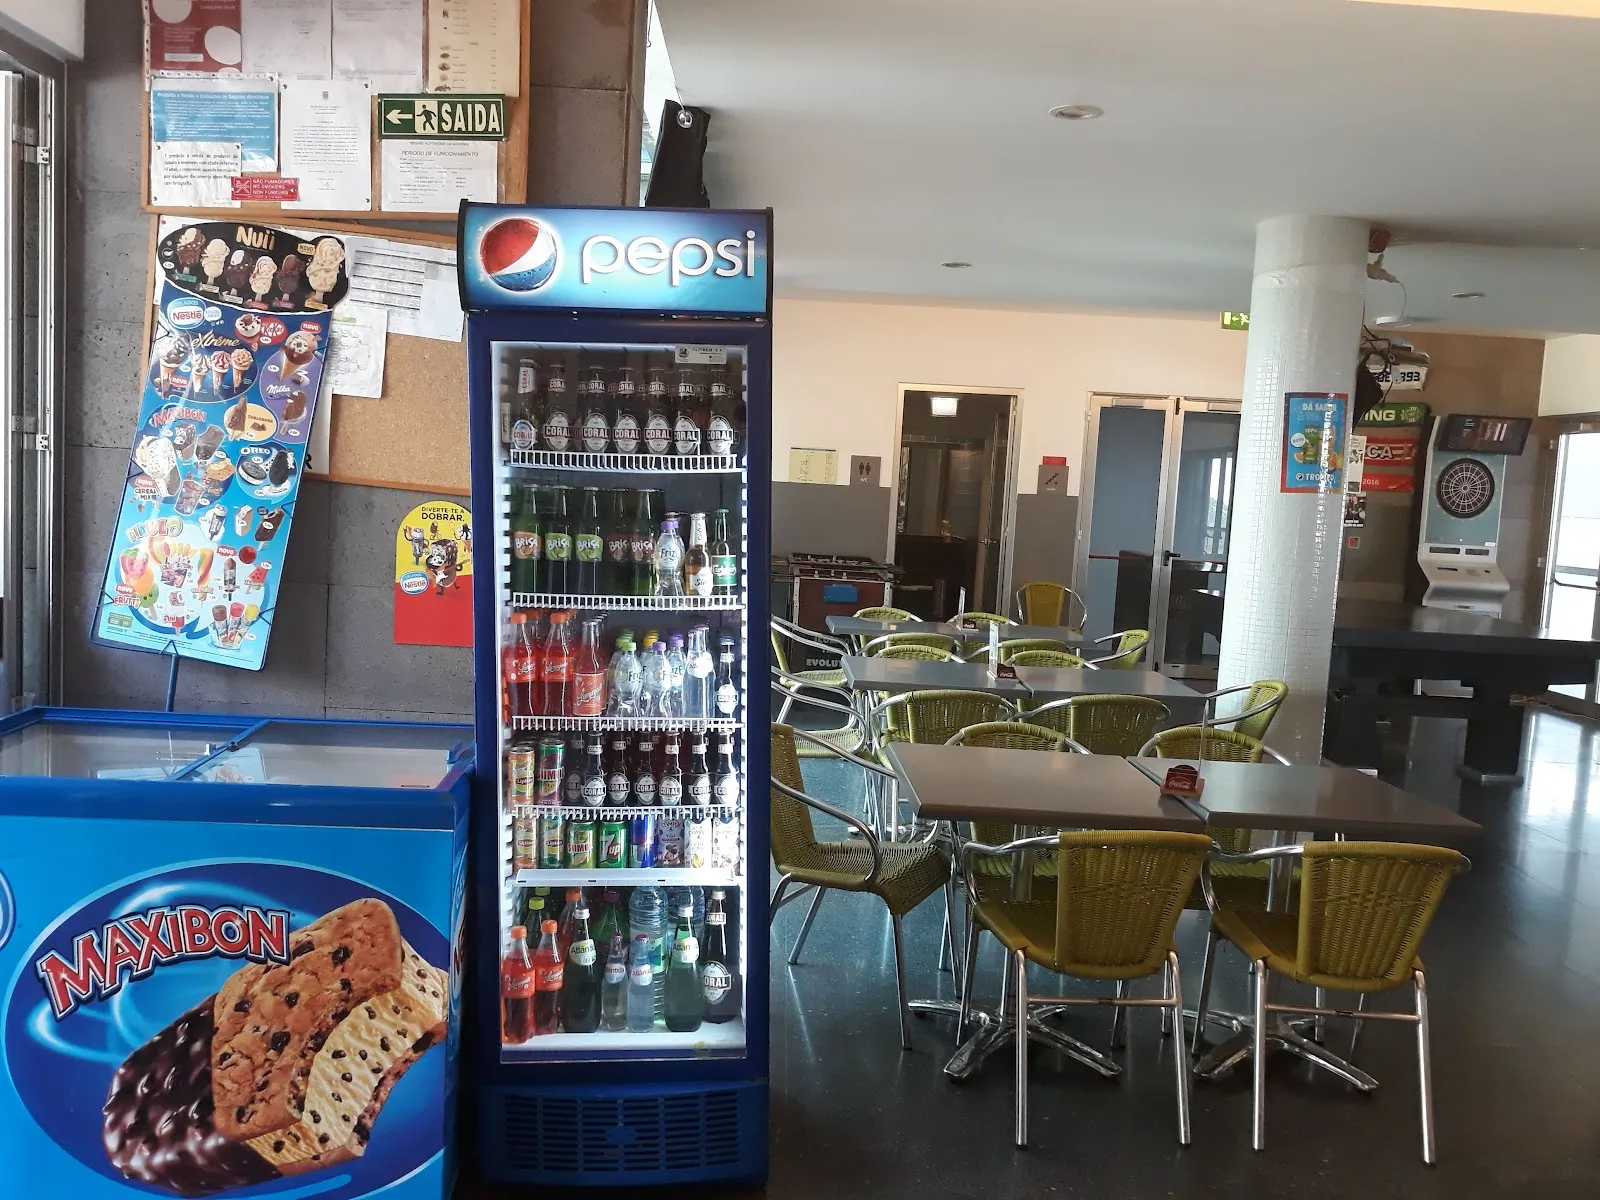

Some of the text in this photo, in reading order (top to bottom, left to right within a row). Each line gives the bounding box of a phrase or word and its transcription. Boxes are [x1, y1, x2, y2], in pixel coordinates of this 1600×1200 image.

[441, 102, 501, 132] SAIDA
[582, 230, 756, 287] pepsi
[173, 310, 202, 321] Nestlé
[266, 384, 291, 395] Milka
[1302, 401, 1313, 411] DÁ
[545, 426, 571, 437] CORAL
[583, 427, 609, 438] CORAL
[614, 428, 640, 439] CORAL
[645, 428, 671, 439] CORAL
[674, 430, 698, 441] CORAL
[706, 429, 732, 440] CORAL
[240, 447, 270, 455] OREO
[421, 513, 465, 522] DOBRAR.
[806, 658, 841, 667] EVOLU
[584, 788, 605, 797] CORAL
[660, 787, 680, 796] CORAL
[36, 905, 291, 1021] MAXIBON
